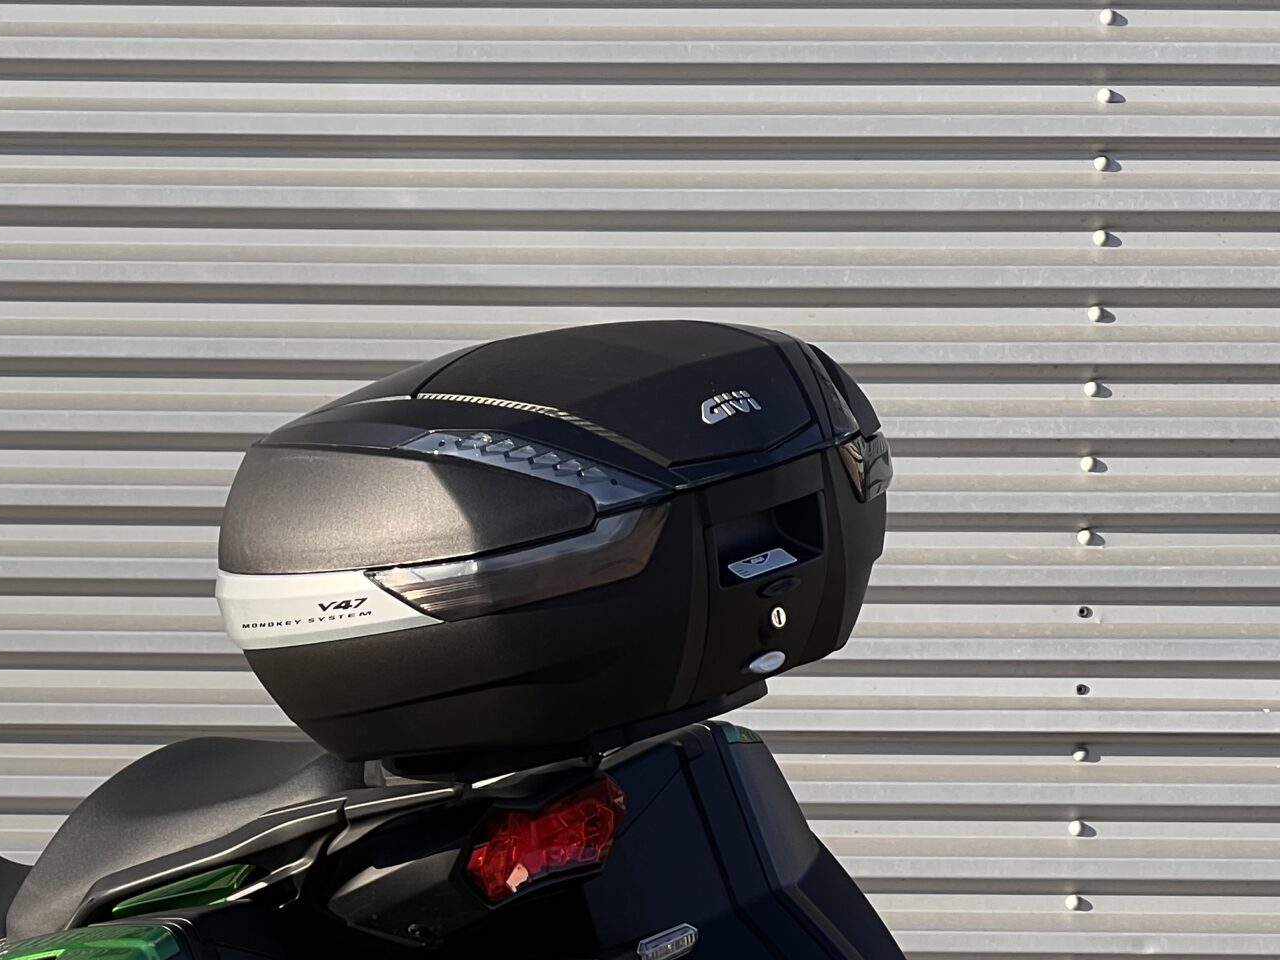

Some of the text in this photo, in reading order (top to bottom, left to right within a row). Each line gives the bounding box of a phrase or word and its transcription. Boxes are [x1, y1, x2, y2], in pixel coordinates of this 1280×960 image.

[701, 390, 762, 424] GIVI
[318, 597, 368, 612] V47
[242, 610, 372, 629] MONOKEY SYSTEM
